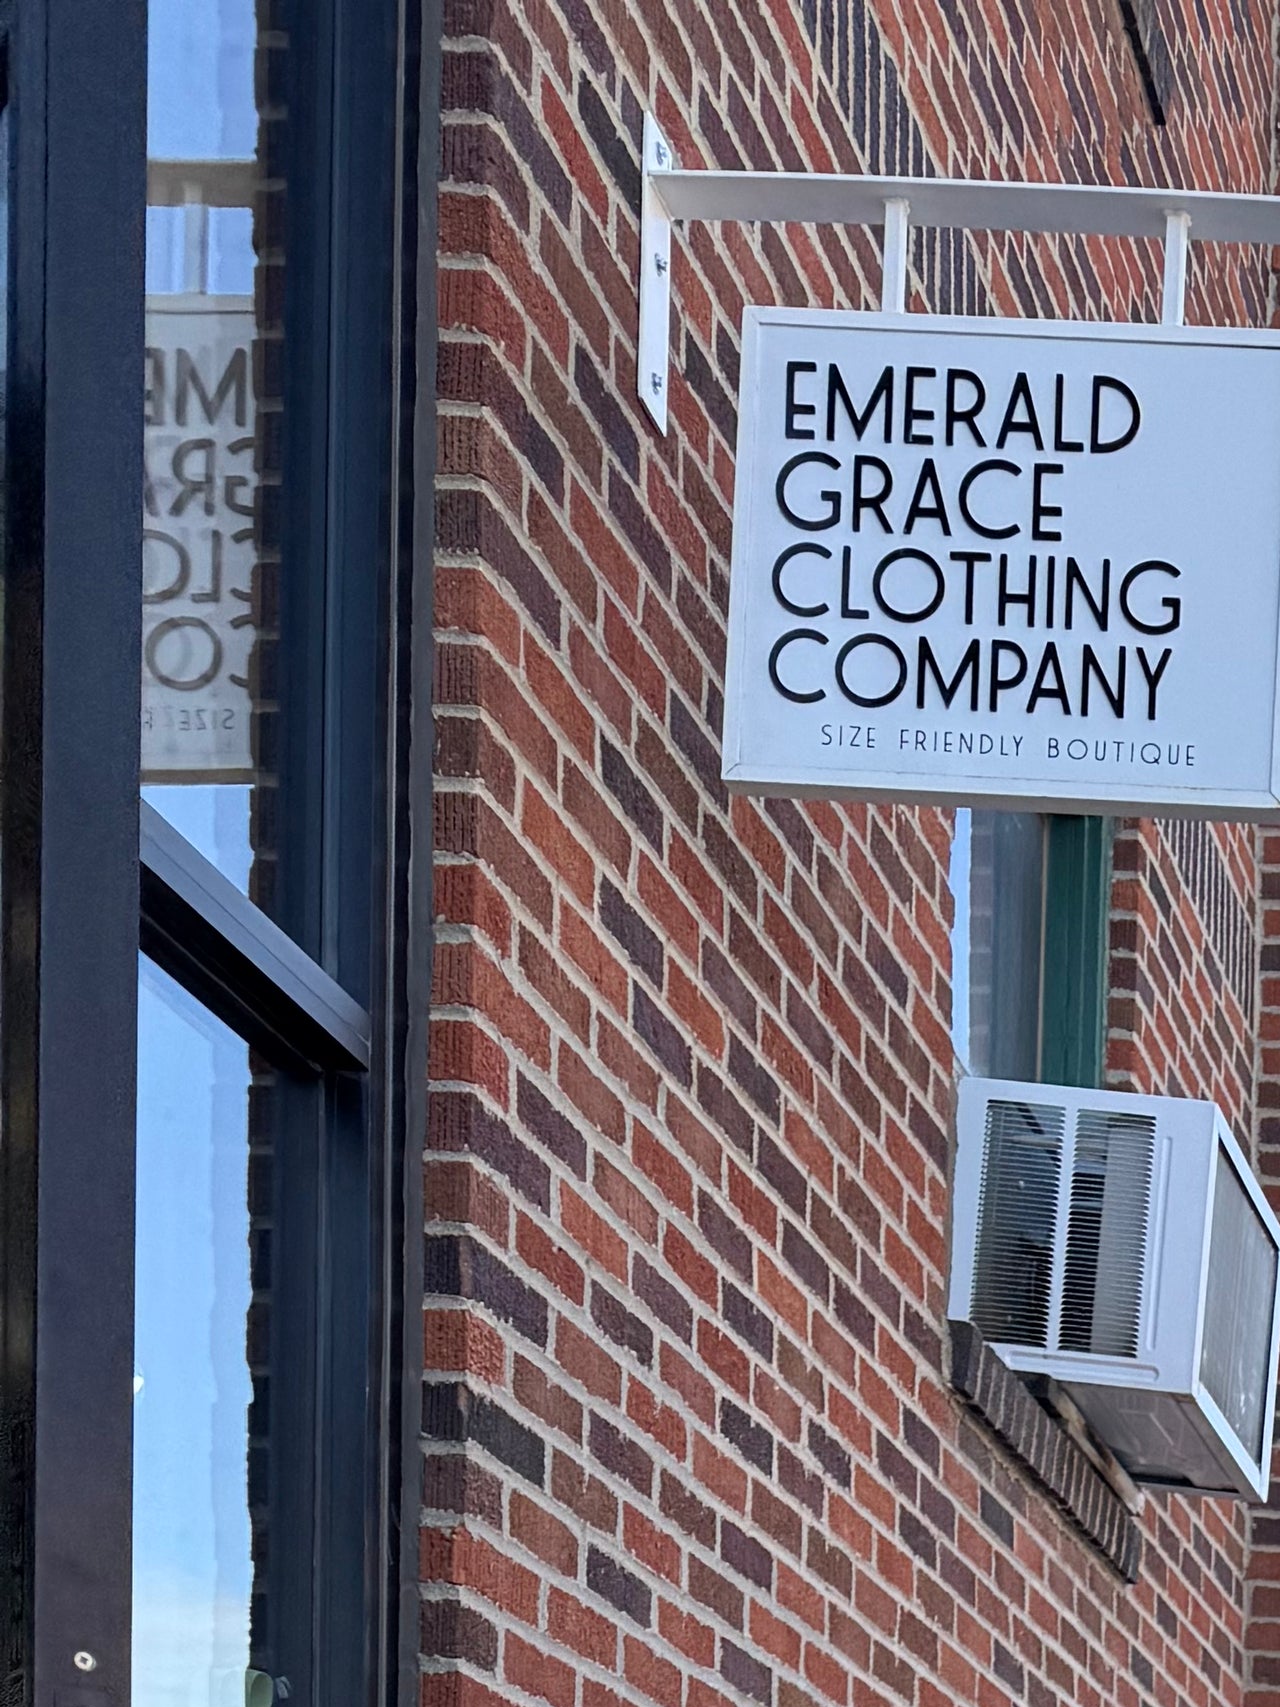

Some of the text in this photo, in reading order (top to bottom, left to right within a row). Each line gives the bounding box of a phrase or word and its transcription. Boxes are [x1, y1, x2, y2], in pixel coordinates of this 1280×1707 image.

[785, 360, 1142, 454] EMERALD
[775, 451, 1064, 541] GRACE
[771, 542, 1182, 636] CLOTHING
[768, 628, 1172, 721] COMPANY
[820, 723, 1196, 767] SIZE FRIENDLY BOUTIQUE
